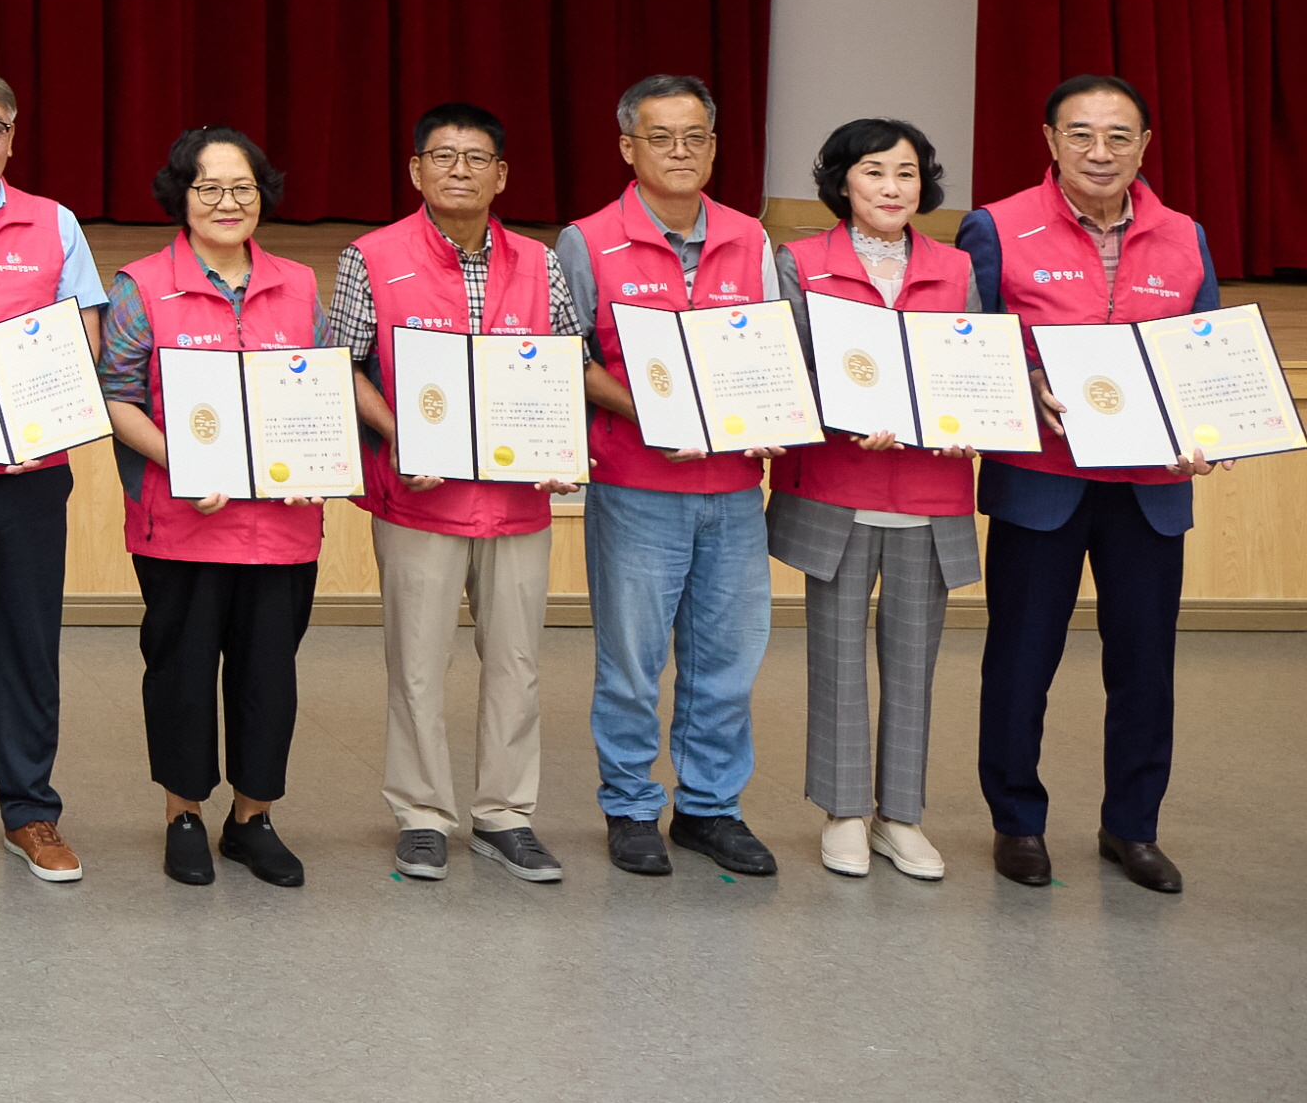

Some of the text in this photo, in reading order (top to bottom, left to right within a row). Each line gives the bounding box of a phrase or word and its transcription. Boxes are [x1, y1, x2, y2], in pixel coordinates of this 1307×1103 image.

[1052, 270, 1084, 281] 통영시
[638, 283, 668, 293] 통영시
[423, 318, 453, 328] 통영시
[193, 334, 222, 344] 통영시
